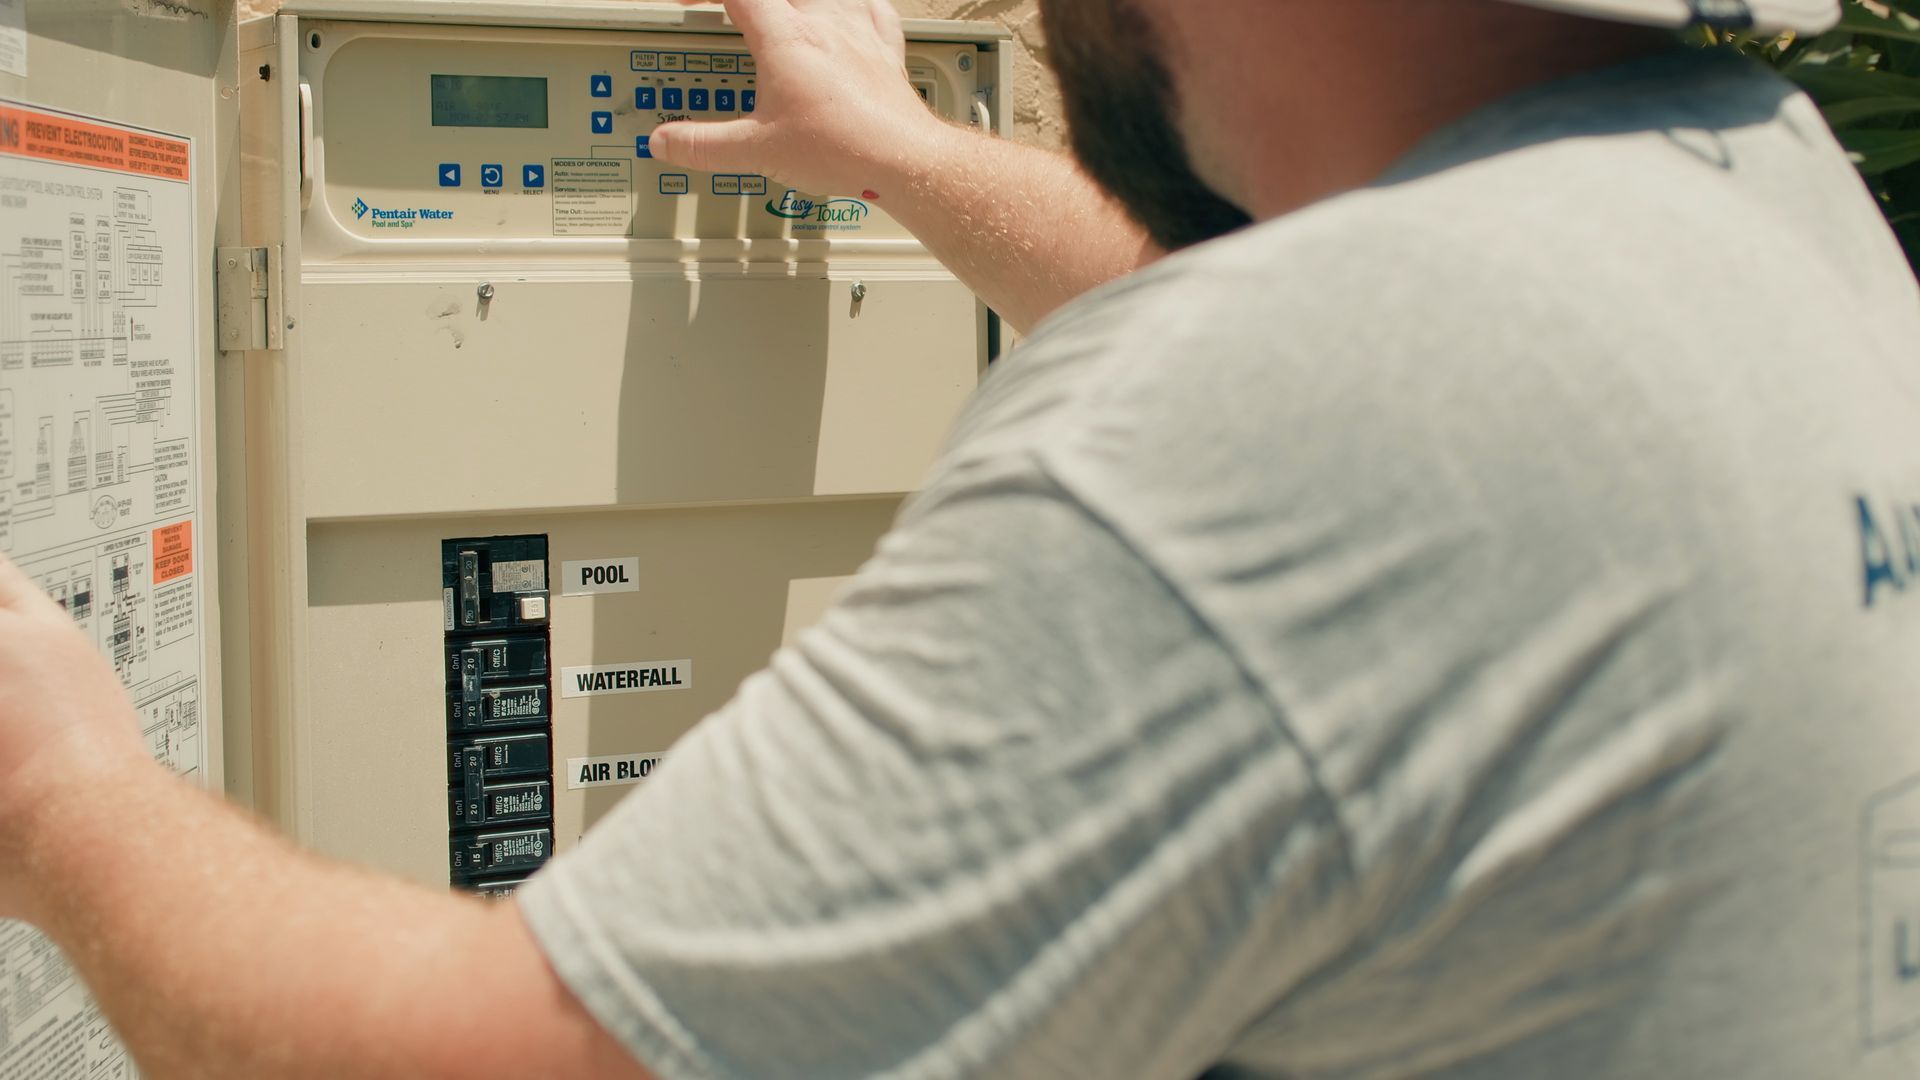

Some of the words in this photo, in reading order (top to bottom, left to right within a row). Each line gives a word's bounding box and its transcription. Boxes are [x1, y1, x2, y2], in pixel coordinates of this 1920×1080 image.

[642, 94, 648, 103] F
[670, 94, 674, 103] 1
[696, 95, 702, 104] 2
[722, 96, 728, 105] 3
[748, 97, 754, 105] 4
[780, 190, 814, 220] Easy
[372, 208, 416, 219] Pentair
[419, 209, 453, 219] Water
[155, 559, 171, 570] KEEP
[172, 553, 189, 565] DOOR
[161, 565, 184, 579] CLOSED
[582, 565, 629, 585] POOL
[468, 658, 474, 669] 20
[576, 667, 682, 692] WATERFALL
[469, 706, 475, 717] 20
[470, 756, 477, 766] 20
[580, 763, 610, 782] AIR
[470, 804, 477, 815] 20
[473, 854, 480, 862] 15
